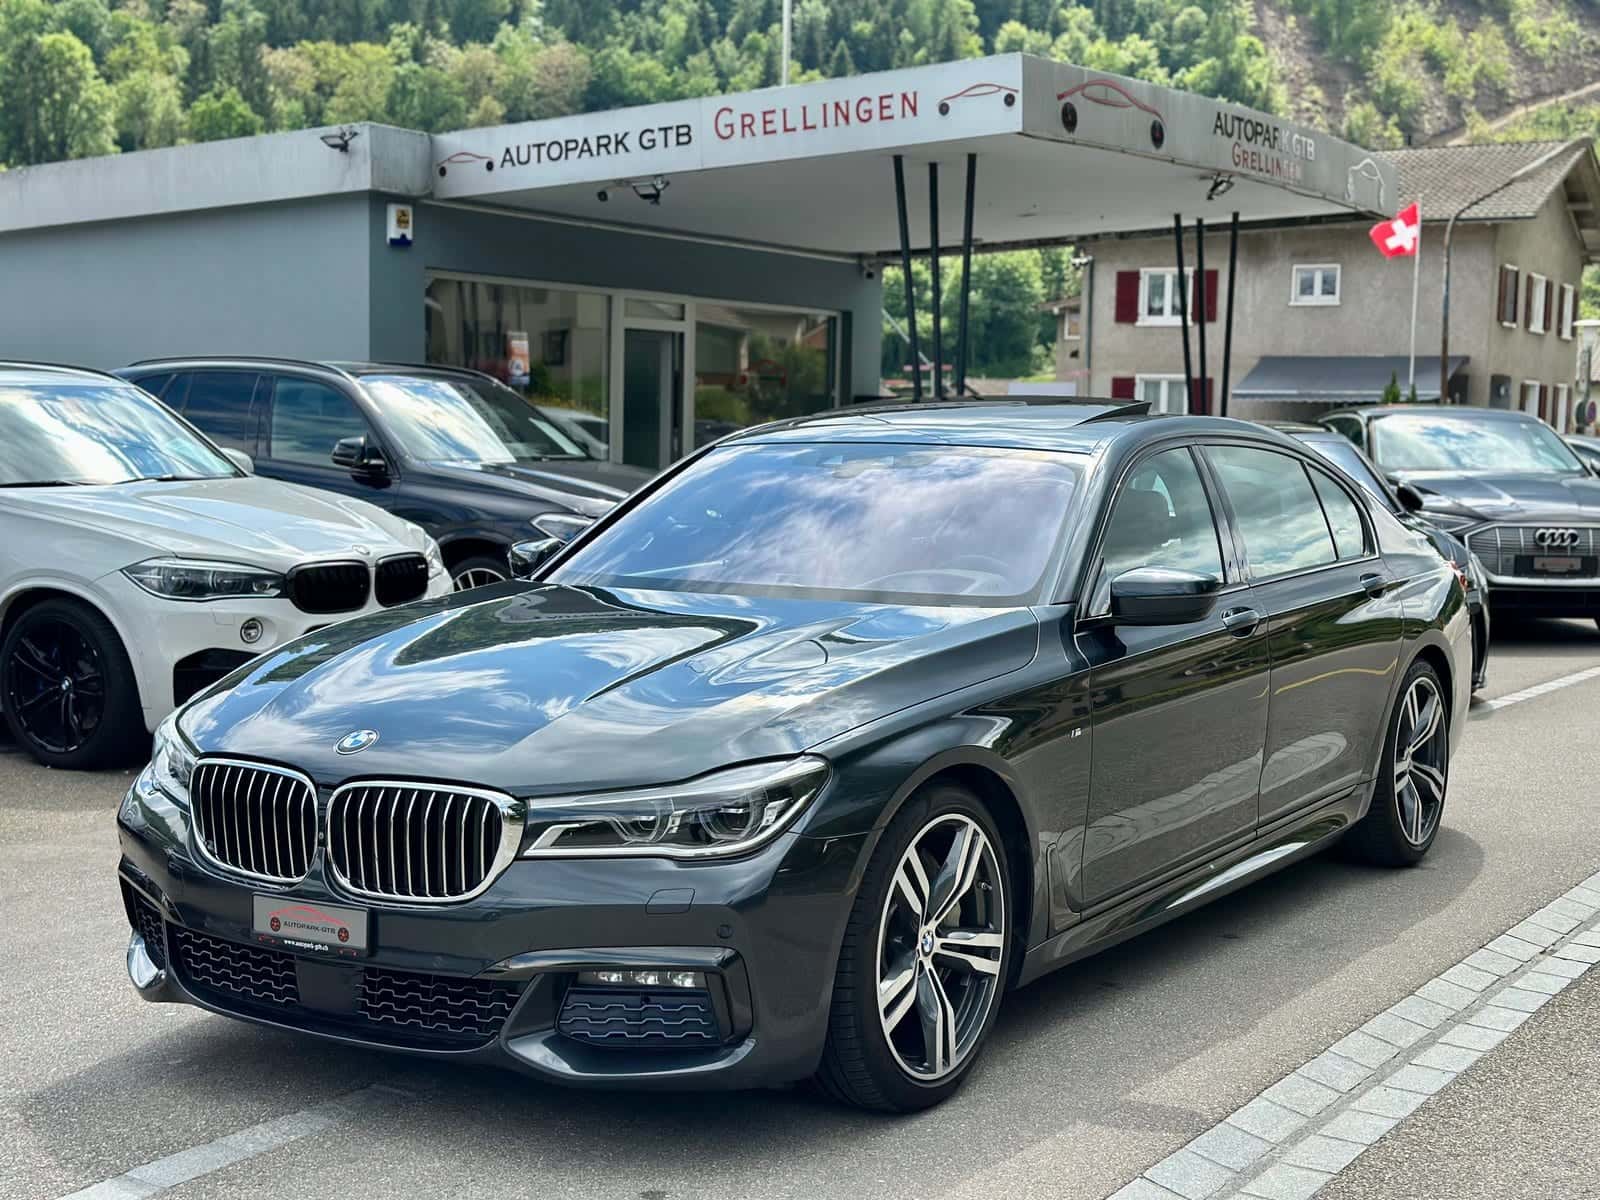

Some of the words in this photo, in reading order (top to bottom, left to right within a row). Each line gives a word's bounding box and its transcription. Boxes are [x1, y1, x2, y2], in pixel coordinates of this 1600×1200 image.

[500, 131, 630, 169] AUTOPARK
[638, 124, 693, 151] GTB
[713, 91, 919, 140] GRELLINGEN
[1292, 132, 1315, 161] GTB
